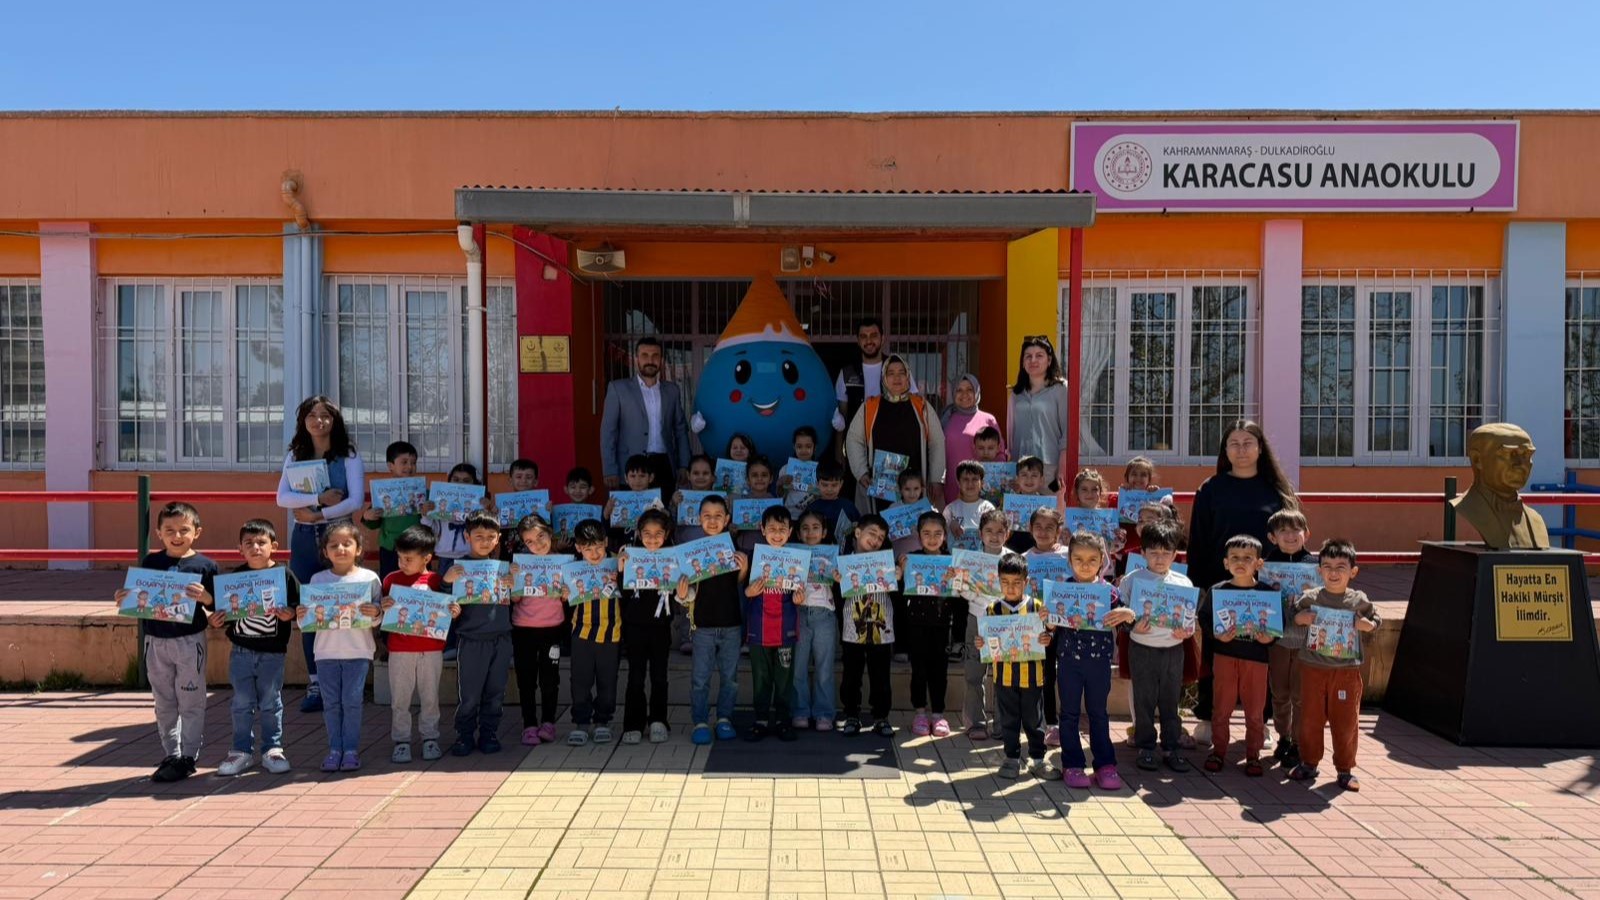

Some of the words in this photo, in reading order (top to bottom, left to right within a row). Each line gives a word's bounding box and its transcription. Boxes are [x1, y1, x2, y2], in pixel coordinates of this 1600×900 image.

[1163, 146, 1253, 158] KAHRAMANMARAŞ
[1260, 144, 1336, 156] DULKADİROĞLU
[1163, 162, 1313, 188] KARACASU
[1320, 162, 1476, 188] ANAOKULU
[1506, 573, 1542, 588] Hayatta
[1545, 573, 1557, 585] En
[1501, 591, 1531, 603] Hakiki
[1533, 590, 1564, 606] Mürşit
[1516, 606, 1551, 621] İlimdir.
